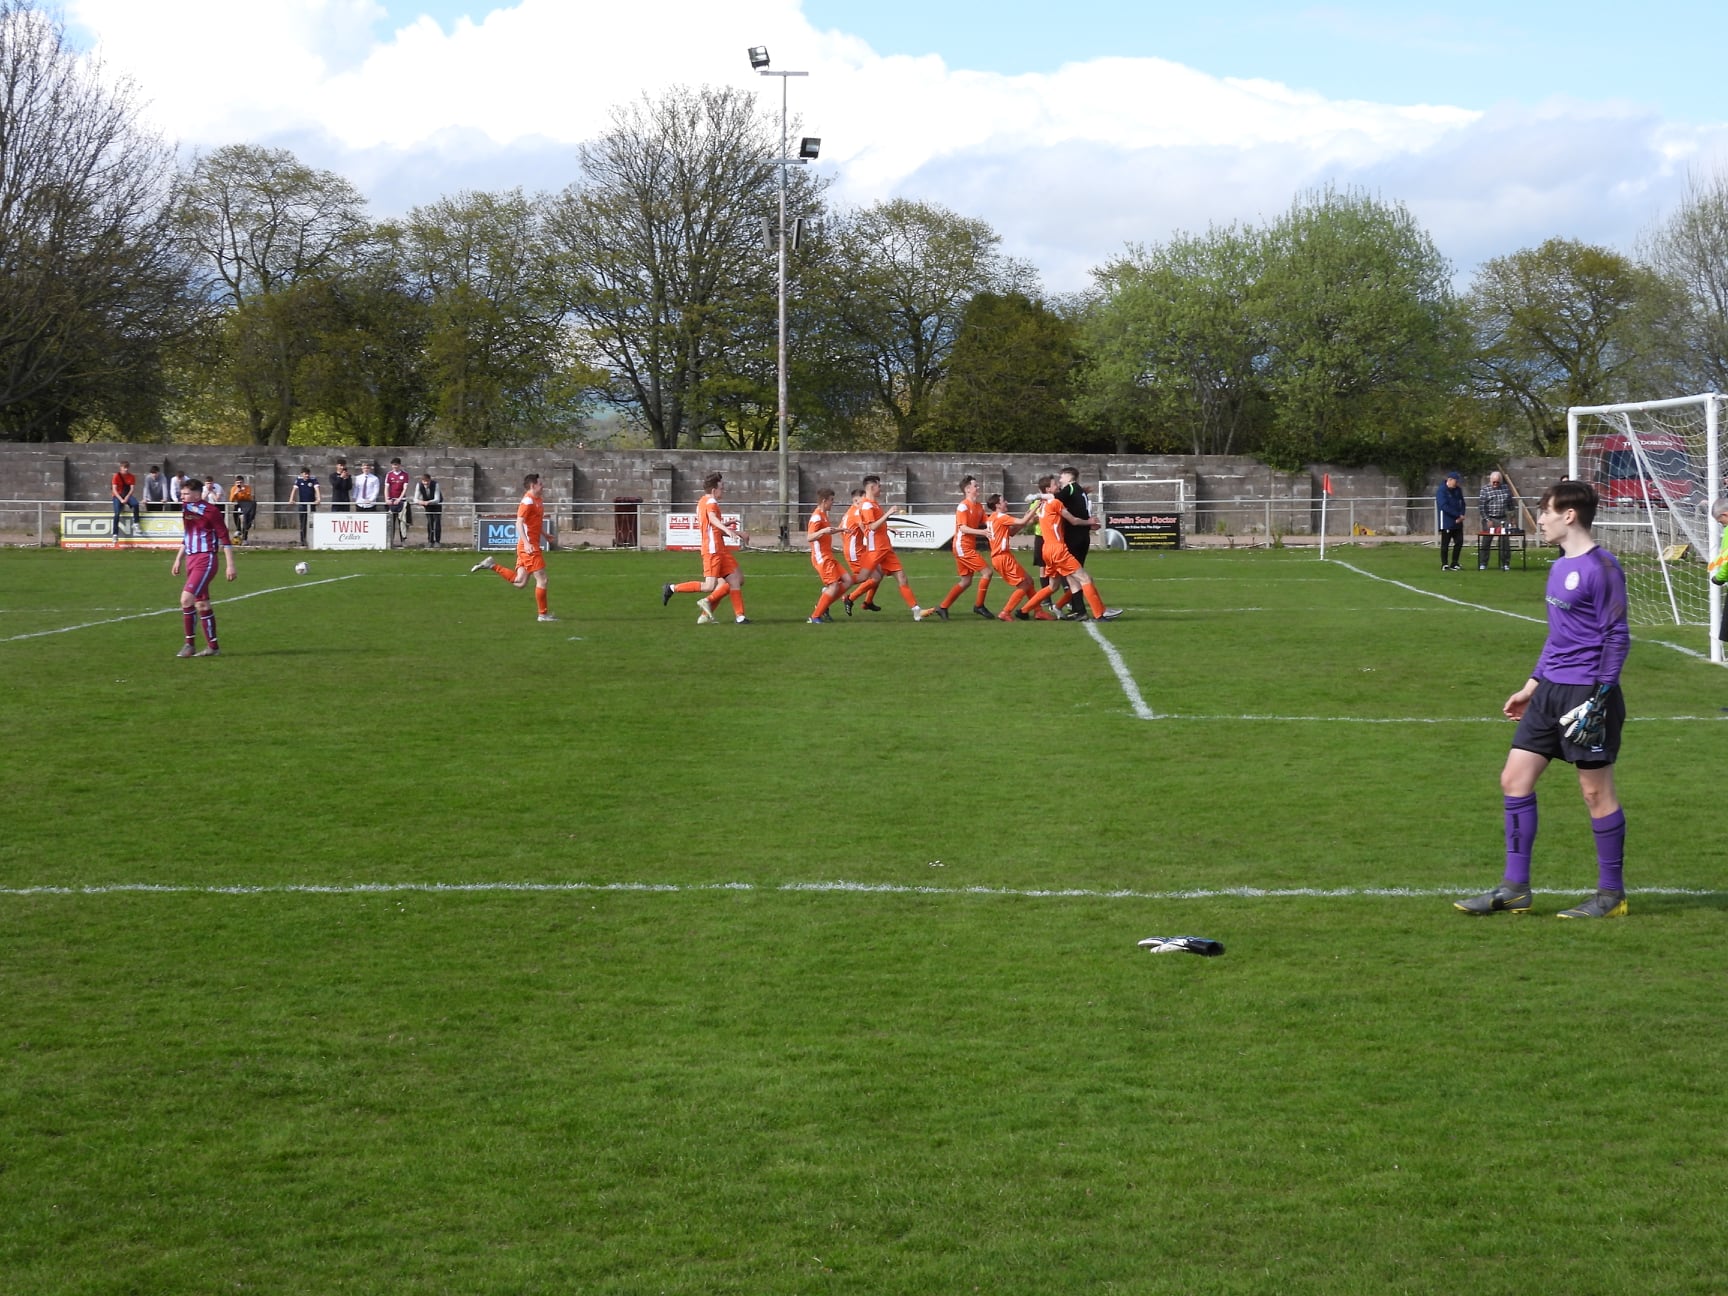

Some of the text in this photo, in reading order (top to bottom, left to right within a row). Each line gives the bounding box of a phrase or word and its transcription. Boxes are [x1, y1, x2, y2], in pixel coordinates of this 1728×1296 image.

[331, 520, 369, 533] TWINE
[1109, 516, 1177, 524] Javelin Saw Doctor
[66, 519, 131, 535] ICON
